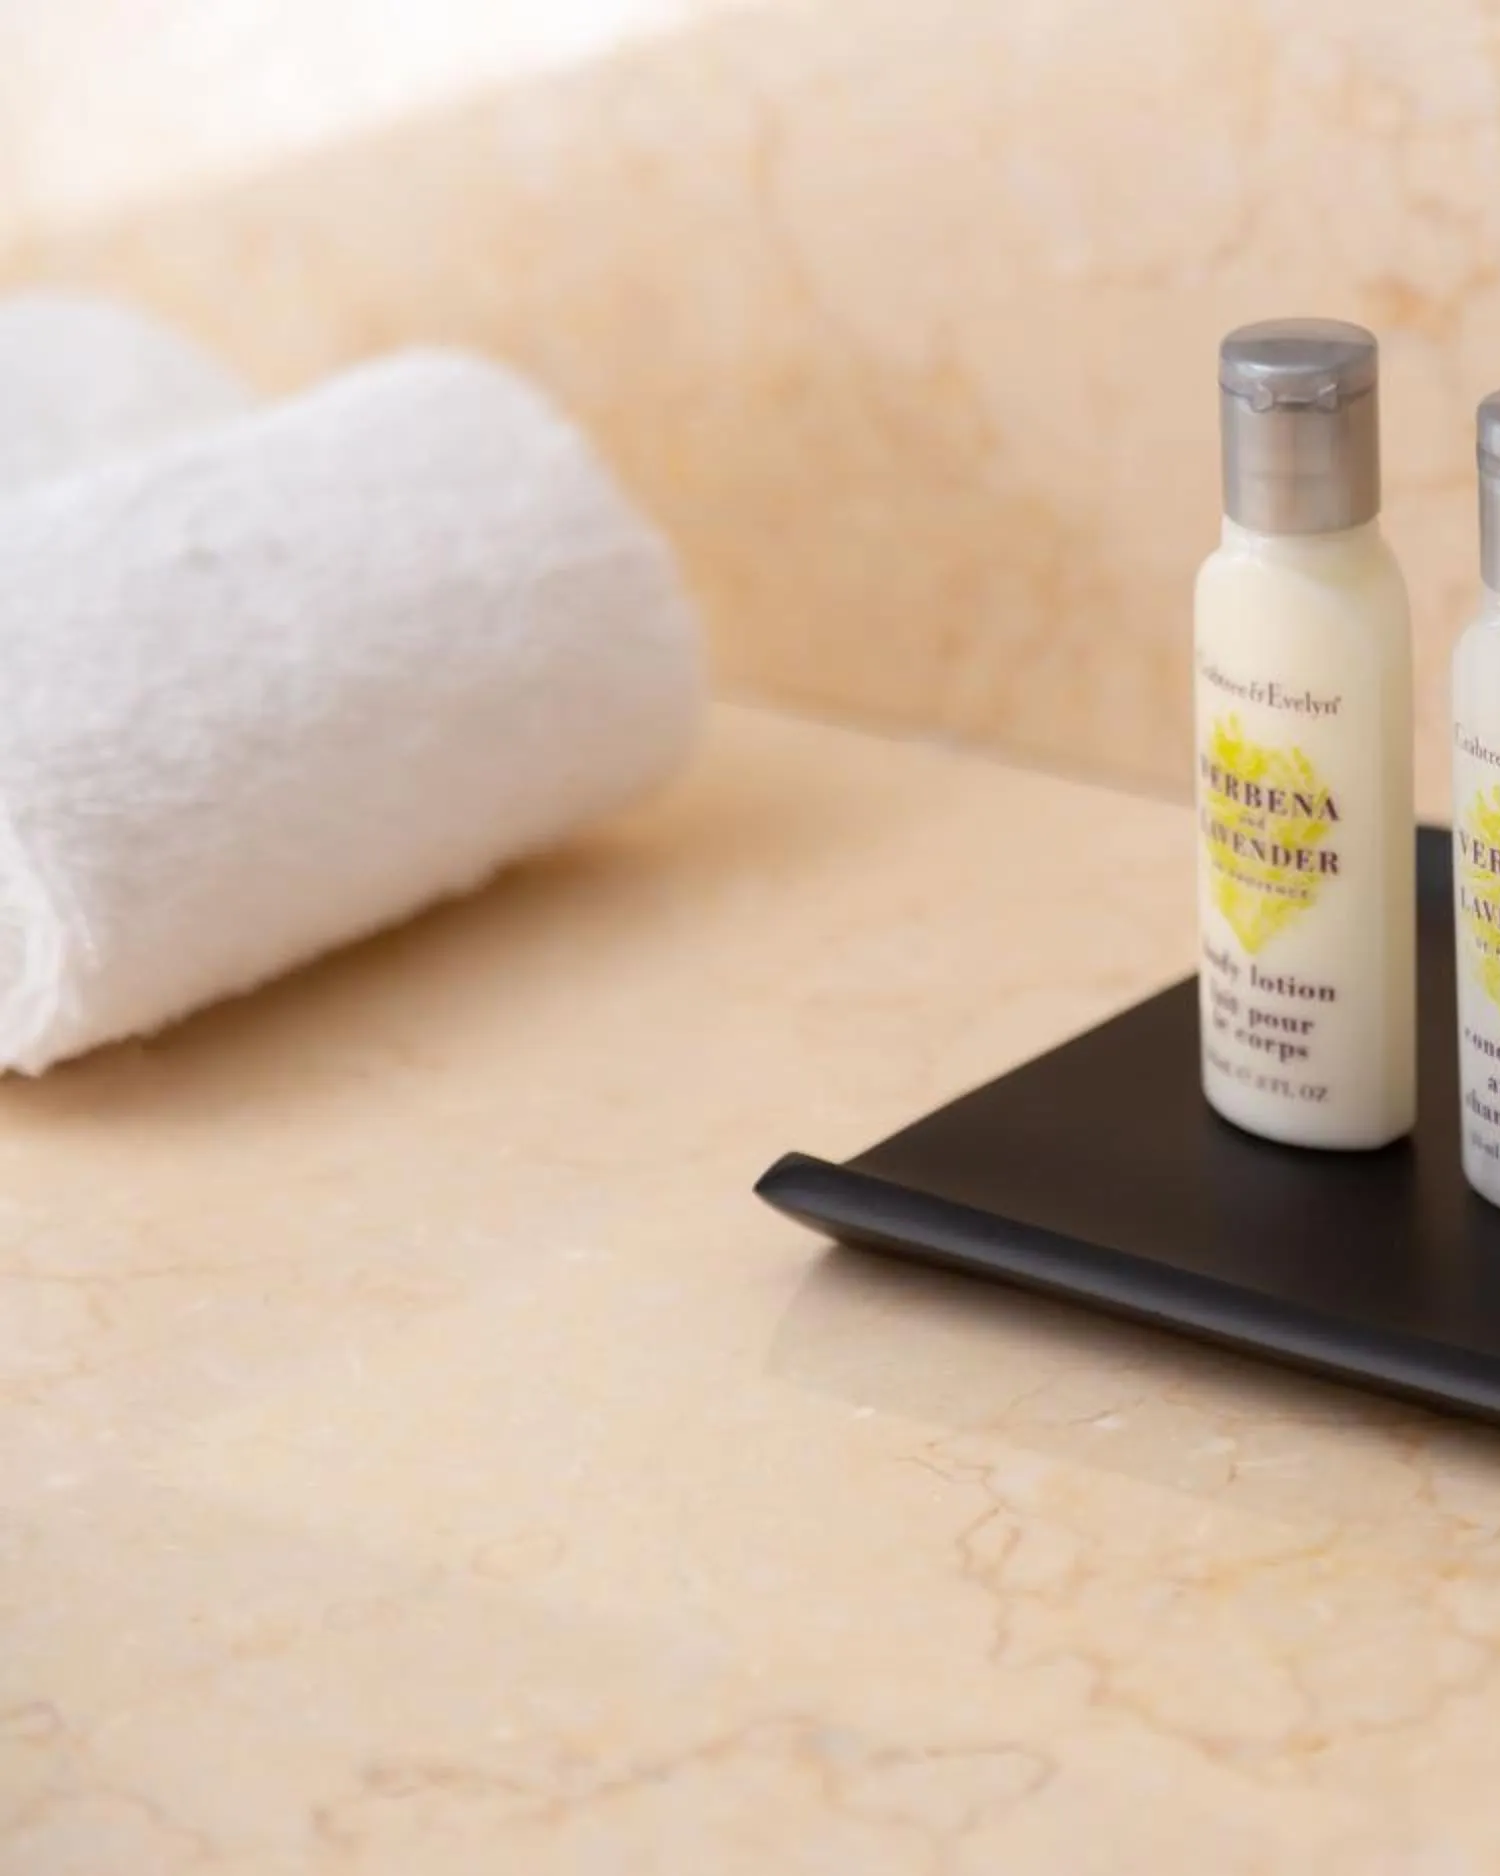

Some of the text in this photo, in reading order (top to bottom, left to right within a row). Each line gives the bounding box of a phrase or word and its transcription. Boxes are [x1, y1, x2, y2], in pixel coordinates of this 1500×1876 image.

[1250, 963, 1336, 1002] lotion
[1248, 1007, 1315, 1036] pour
[1234, 1028, 1309, 1063] corps
